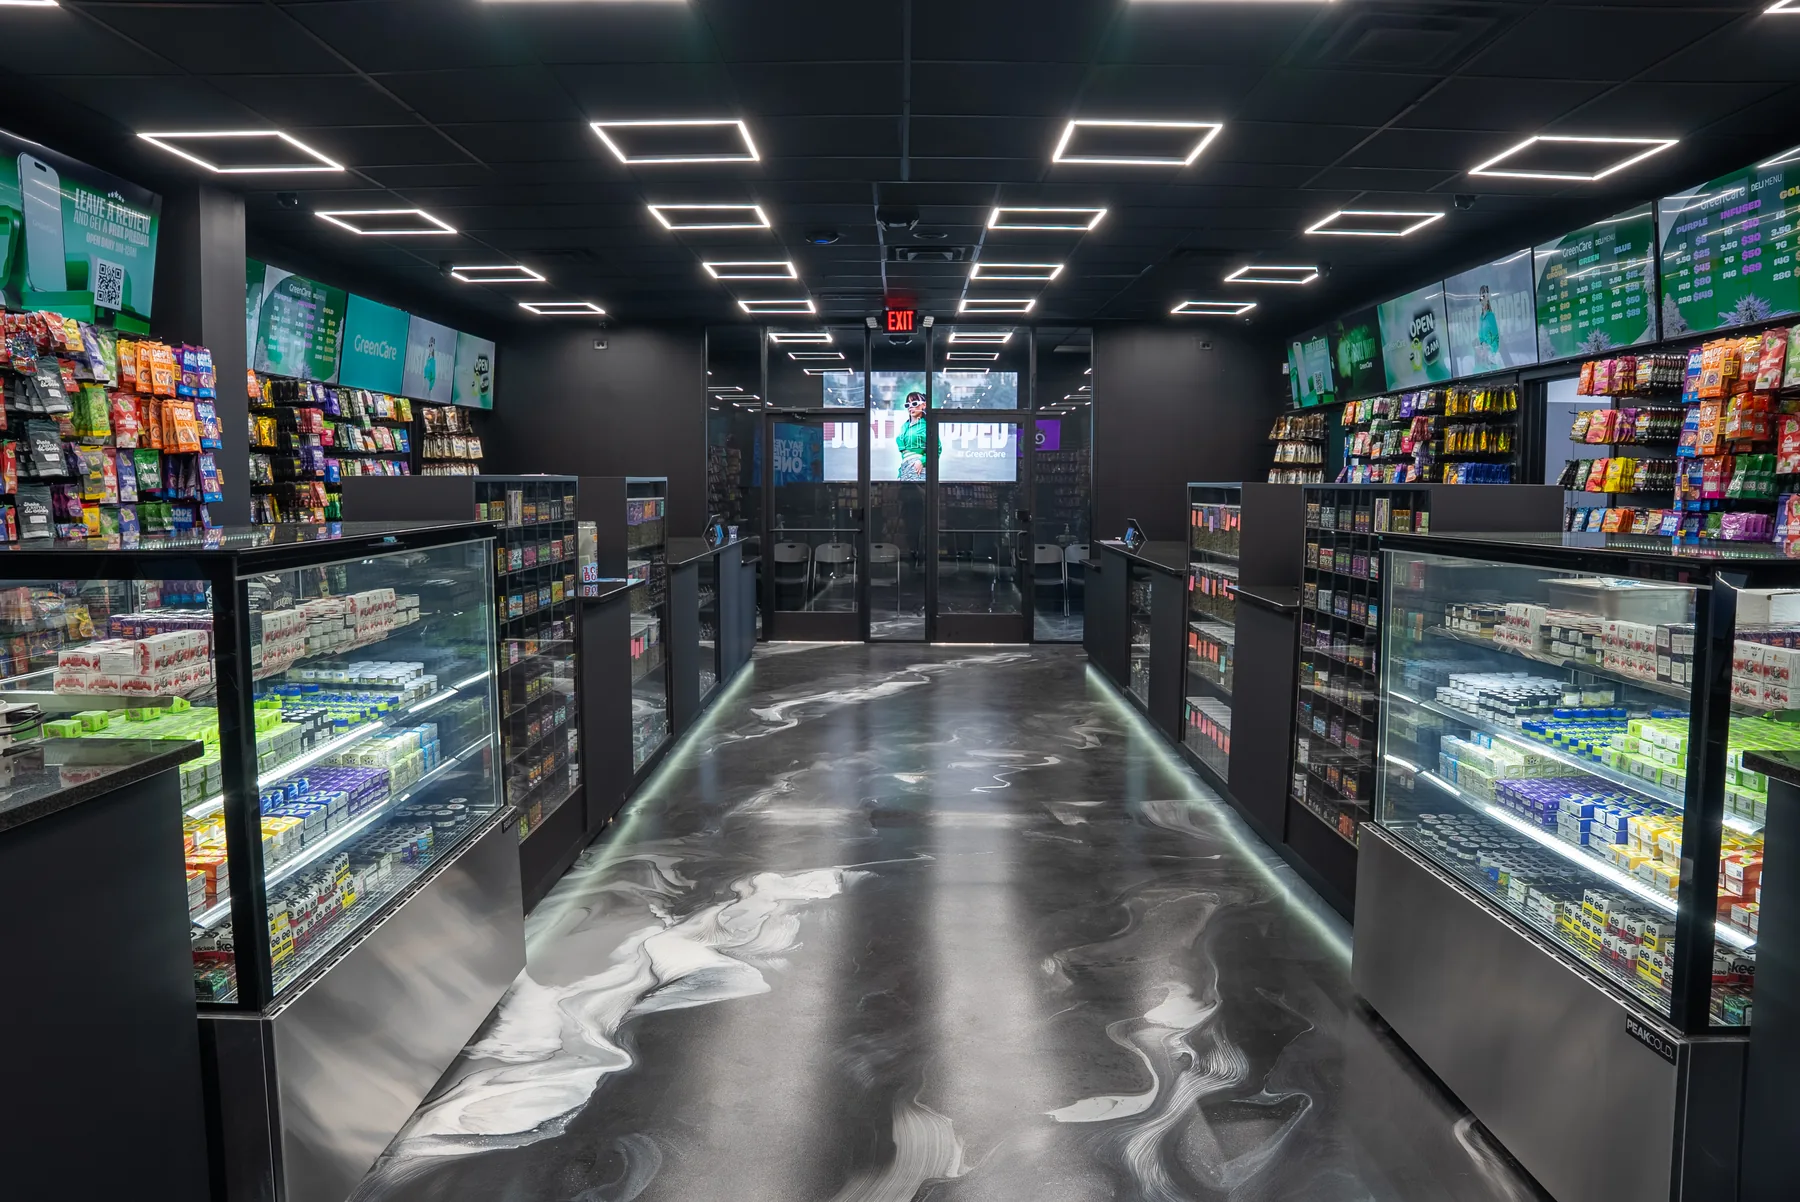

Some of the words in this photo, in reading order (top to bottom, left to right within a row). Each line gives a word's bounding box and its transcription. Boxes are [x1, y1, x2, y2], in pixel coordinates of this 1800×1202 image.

[1764, 174, 1782, 187] MENU
[1780, 185, 1800, 200] GOL
[75, 188, 106, 218] LEAVE
[106, 201, 114, 222] A
[116, 204, 152, 234] REVIEW
[1720, 200, 1761, 220] INFUSED
[74, 210, 88, 226] AND
[90, 215, 102, 232] GET
[1676, 218, 1708, 234] PURPLE
[1562, 240, 1593, 258] GreenCare
[1613, 242, 1632, 254] BLUE
[1578, 253, 1600, 266] GREEN
[288, 283, 312, 298] GreenCare
[888, 310, 914, 330] EXIT
[1410, 312, 1434, 338] OPEN
[354, 334, 397, 360] GreenCare
[152, 348, 170, 360] DOPE
[474, 358, 488, 372] OPEN
[966, 450, 1006, 458] GreenCare
[325, 884, 331, 893] ee
[347, 880, 353, 889] ee
[1585, 895, 1594, 905] ee
[297, 907, 304, 916] ee
[325, 904, 331, 913] ee
[1565, 906, 1572, 916] ee
[1595, 901, 1603, 911] ee
[1582, 920, 1591, 929] ee
[1611, 917, 1619, 926] ee
[282, 930, 290, 940] ee
[297, 926, 303, 936] ee
[1593, 926, 1601, 936] ee
[1627, 925, 1636, 934] ee
[1646, 925, 1656, 936] ee
[272, 937, 280, 947] ee
[1603, 938, 1611, 948] ee
[1619, 947, 1627, 957] ee
[1640, 949, 1650, 961] ee
[1653, 957, 1663, 969] ee
